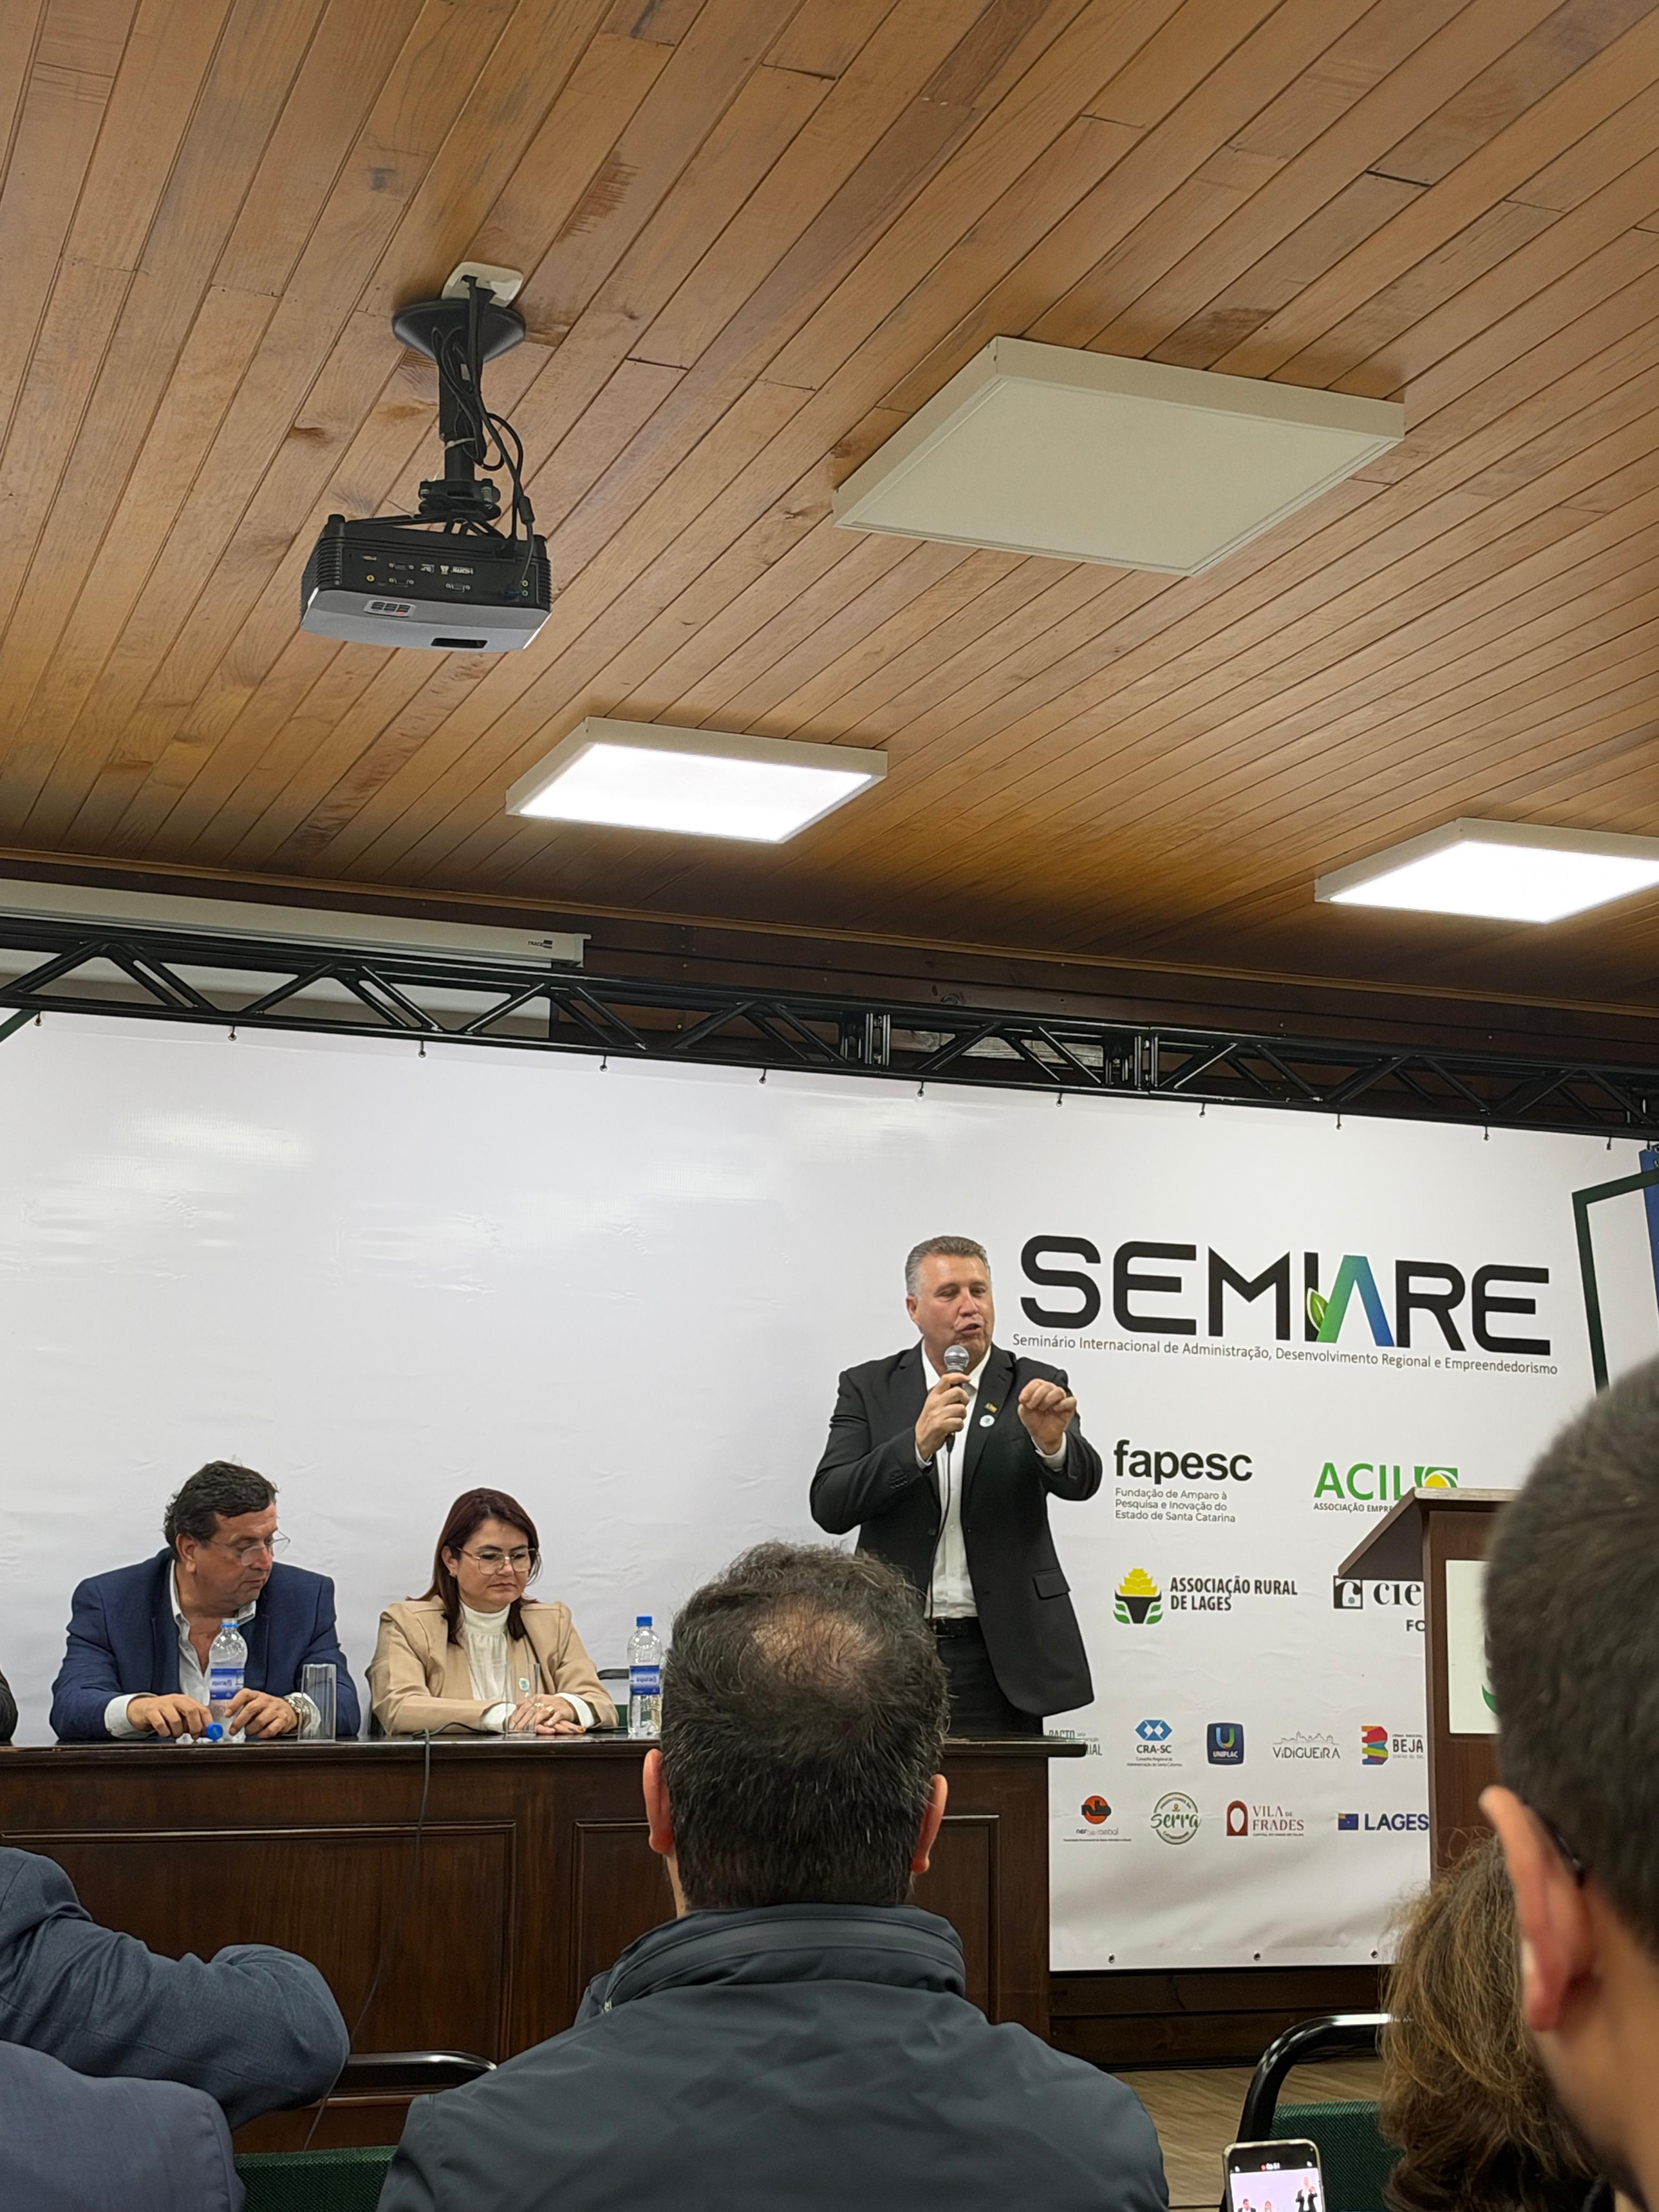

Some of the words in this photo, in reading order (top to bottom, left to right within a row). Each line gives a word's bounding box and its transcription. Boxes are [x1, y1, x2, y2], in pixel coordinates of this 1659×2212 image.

[1020, 1235, 1551, 1355] SEMIARE
[1012, 1333, 1076, 1348] Seminário
[1079, 1337, 1160, 1353] Internacional
[1163, 1340, 1179, 1354] de
[1183, 1342, 1272, 1361] Administração,
[1276, 1347, 1378, 1365] Desenvolvimento
[1382, 1353, 1431, 1369] Regional
[1435, 1359, 1442, 1368] e
[1445, 1358, 1558, 1375] Empreendedorismo
[1113, 1439, 1253, 1485] fapesc
[1314, 1462, 1404, 1501] ACIL
[1115, 1487, 1163, 1499] Fundação
[1166, 1489, 1178, 1498] de
[1180, 1490, 1219, 1501] Amparo
[1221, 1491, 1227, 1500] à
[1115, 1498, 1159, 1510] Pesquisa
[1169, 1501, 1212, 1512] Inovação
[1214, 1502, 1227, 1511] do
[1313, 1502, 1365, 1513] ASSOCIAÇÃO
[1115, 1510, 1149, 1520] Estado
[1151, 1511, 1163, 1520] de
[1166, 1511, 1193, 1521] Santa
[1196, 1512, 1236, 1523] Catarina
[1170, 1576, 1251, 1595] ASSOCIAÇÃO
[1254, 1579, 1298, 1596] RURAL
[1171, 1595, 1188, 1610] DE
[1191, 1595, 1232, 1612] LAGES
[1136, 1745, 1172, 1754] CRA-SC
[1392, 1738, 1423, 1753] BEJA
[1252, 1805, 1284, 1817] VILA
[1252, 1819, 1304, 1831] FRADES
[1364, 1813, 1430, 1831] LAGES
